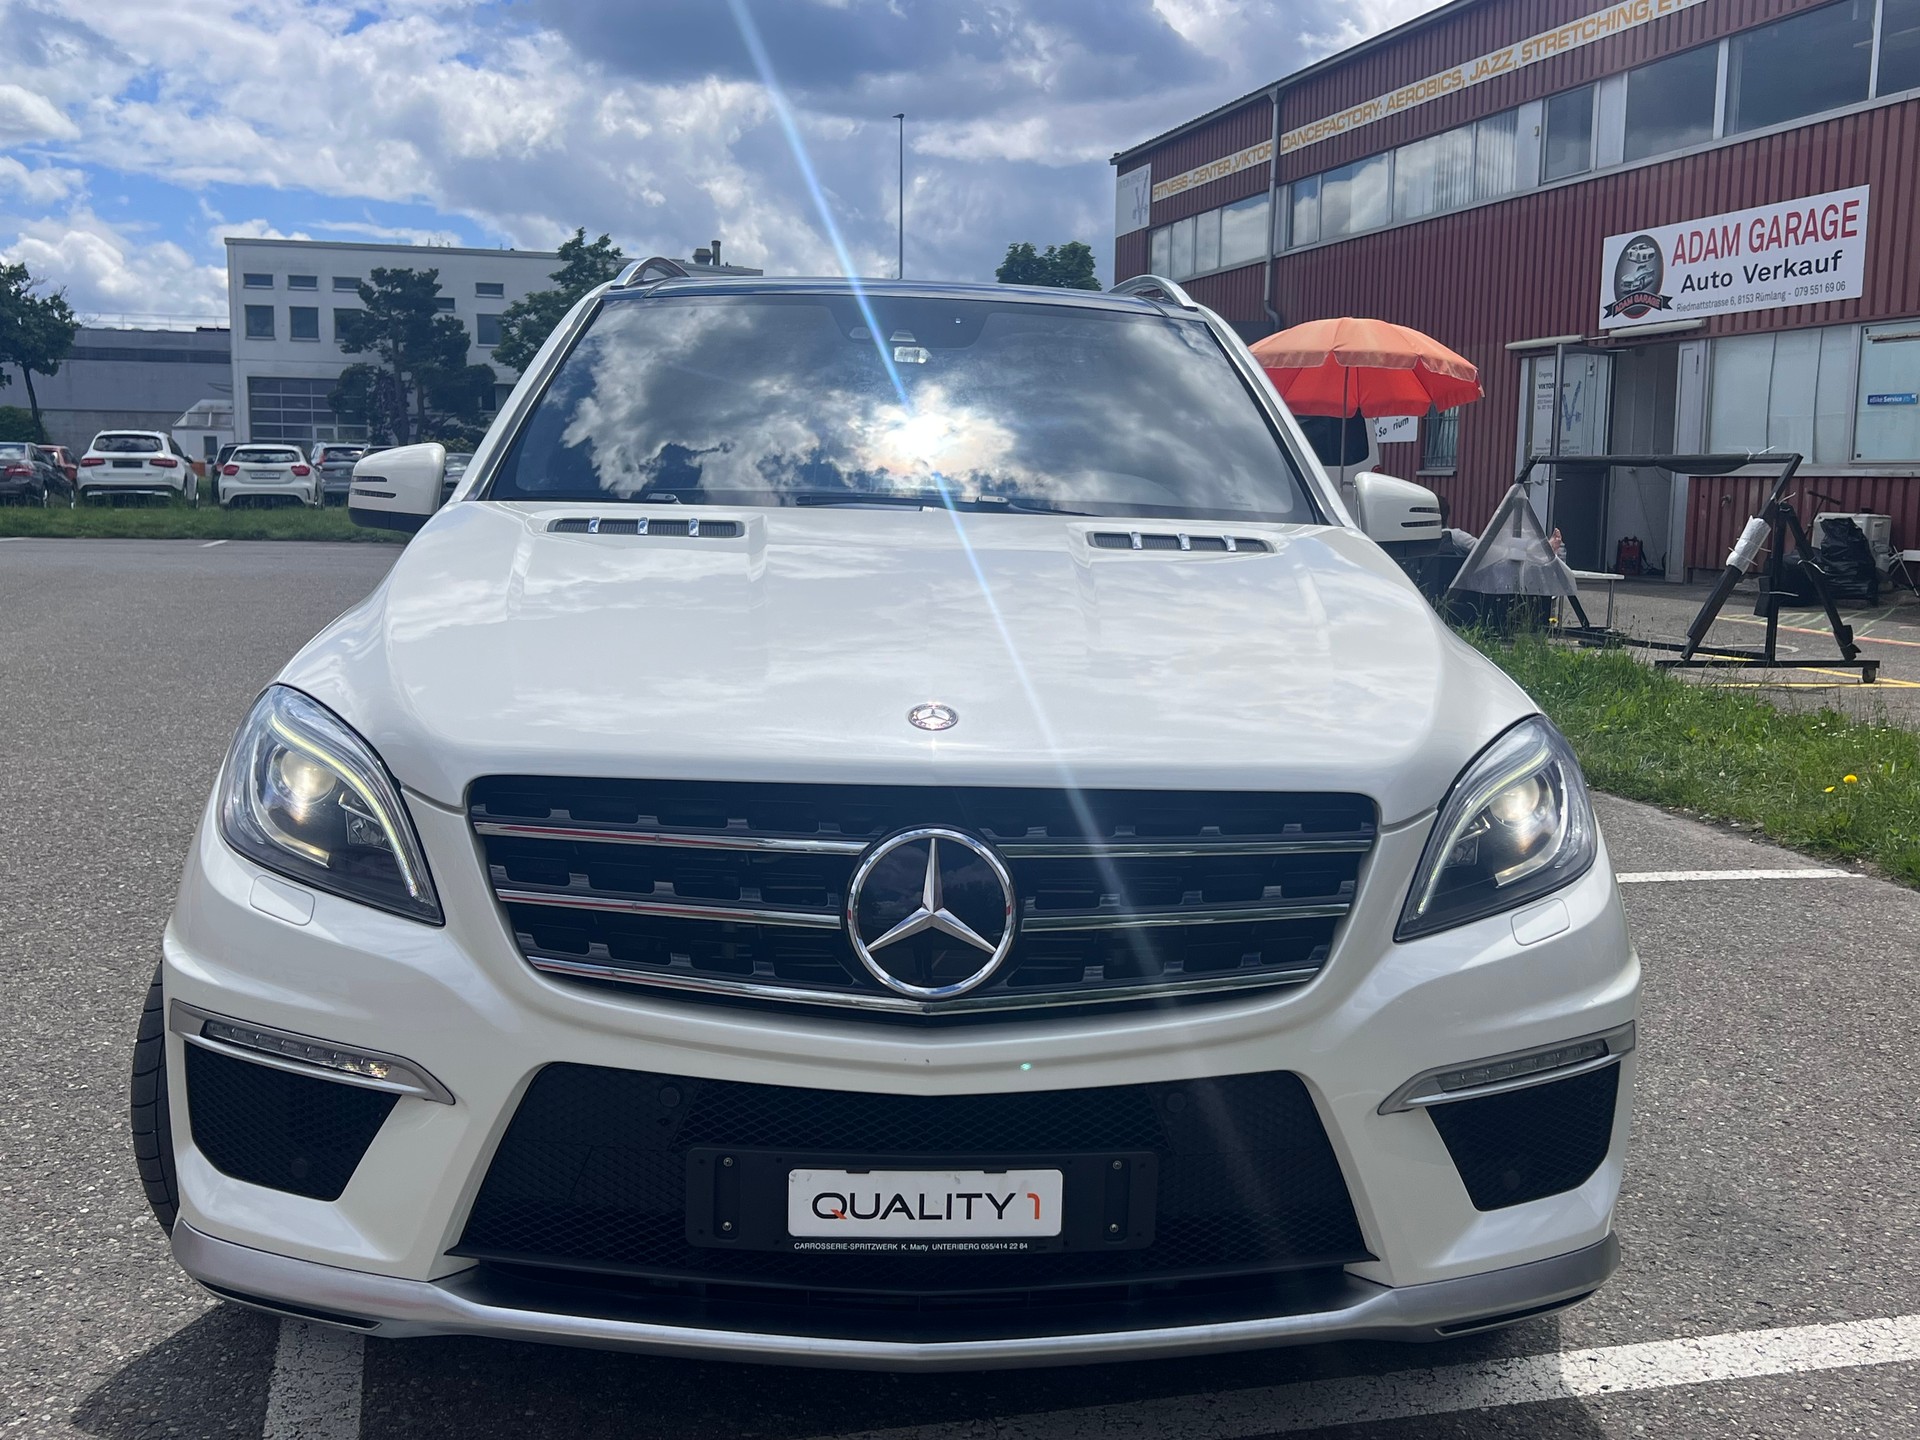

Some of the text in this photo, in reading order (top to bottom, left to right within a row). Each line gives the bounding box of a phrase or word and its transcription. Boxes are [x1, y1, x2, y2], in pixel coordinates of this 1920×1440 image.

[1281, 100, 1383, 151] DANCEFACTORY:
[1385, 69, 1465, 113] AEROBICS,
[1469, 49, 1517, 82] JAZZ,
[1521, 0, 1653, 63] STRETCHING,
[1671, 200, 1860, 267] ADAM GARAGE
[1681, 249, 1843, 294] Auto Verkauf
[1676, 297, 1729, 312] Riedmattstrasse
[1737, 294, 1754, 305] 8153
[1755, 290, 1786, 302] Rümlang
[1794, 286, 1809, 297] 079
[1810, 284, 1823, 295] 551
[1825, 282, 1835, 293] 69
[1836, 280, 1846, 291] 06
[793, 1242, 898, 1251] CARROSSERIE-SPRITZWERK
[909, 1242, 929, 1252] Marty
[980, 1242, 1008, 1250] 055/414
[1009, 1242, 1018, 1250] 22
[1019, 1242, 1028, 1250] 84
